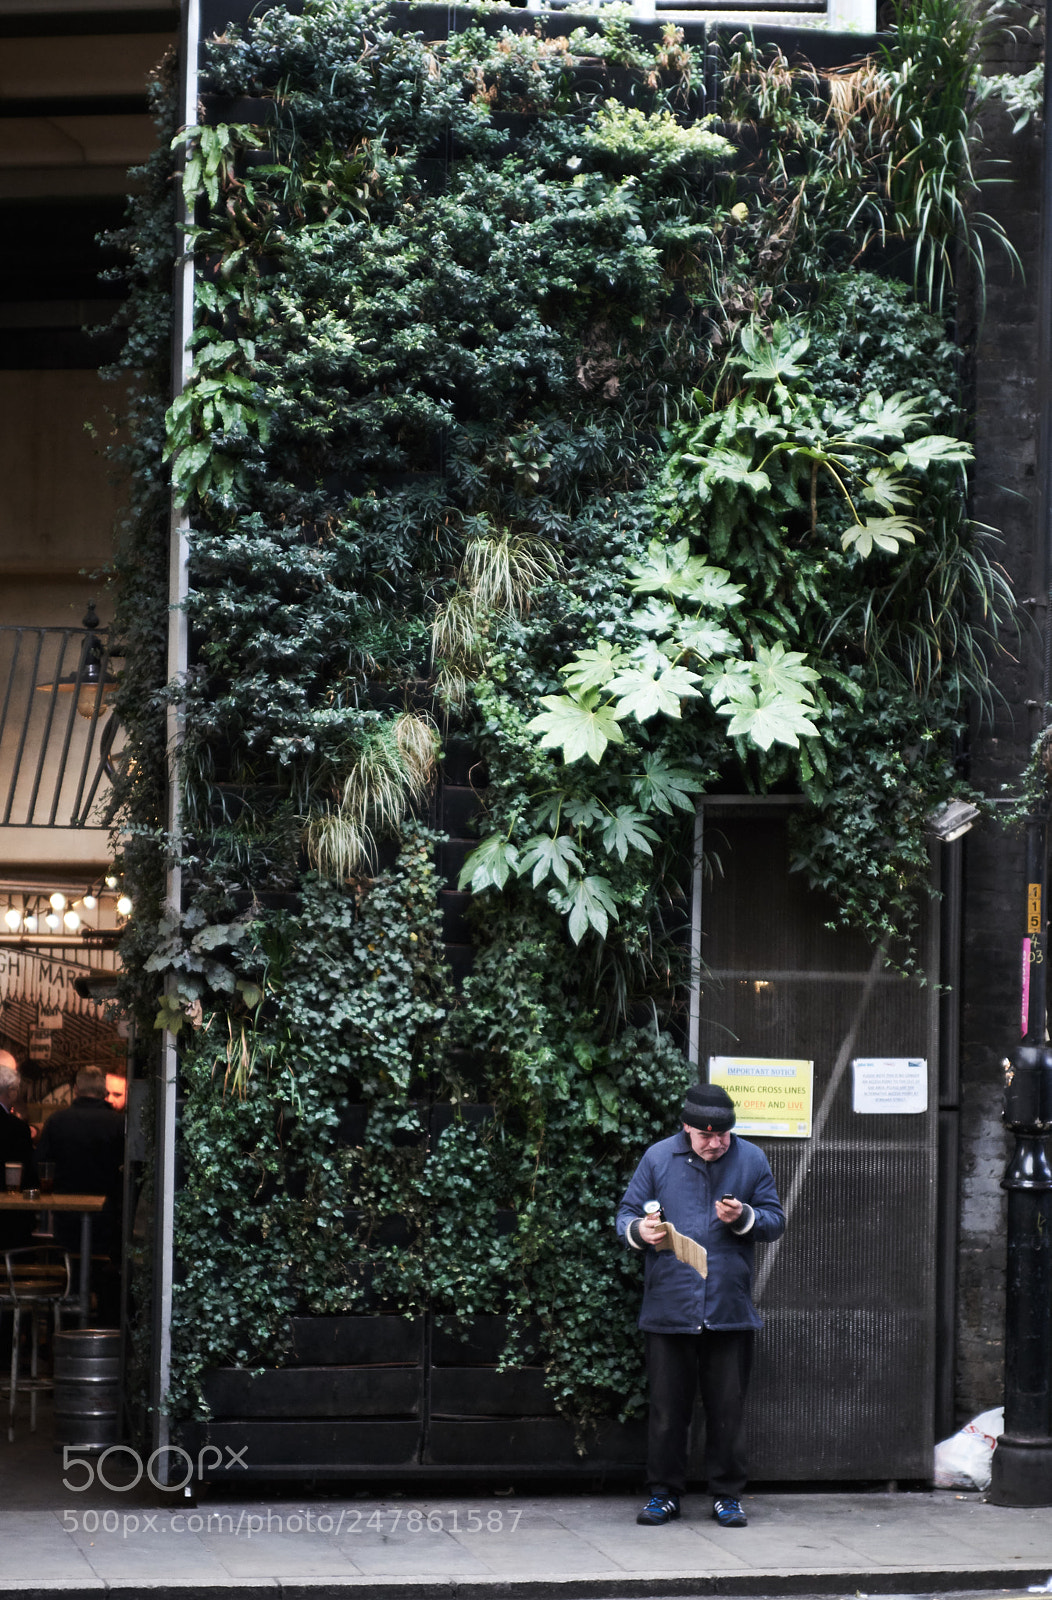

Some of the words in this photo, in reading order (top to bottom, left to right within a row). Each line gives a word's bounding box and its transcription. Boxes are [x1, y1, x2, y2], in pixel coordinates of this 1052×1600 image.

[1030, 886, 1039, 927] 115
[728, 1067, 769, 1076] IMPORTANT
[771, 1068, 796, 1077] NOTICE
[721, 1085, 755, 1093] HARING
[757, 1085, 783, 1094] CROSS
[784, 1087, 806, 1095] LINES
[743, 1100, 766, 1110] OPEN
[768, 1101, 785, 1109] AND
[787, 1102, 804, 1111] LIVE
